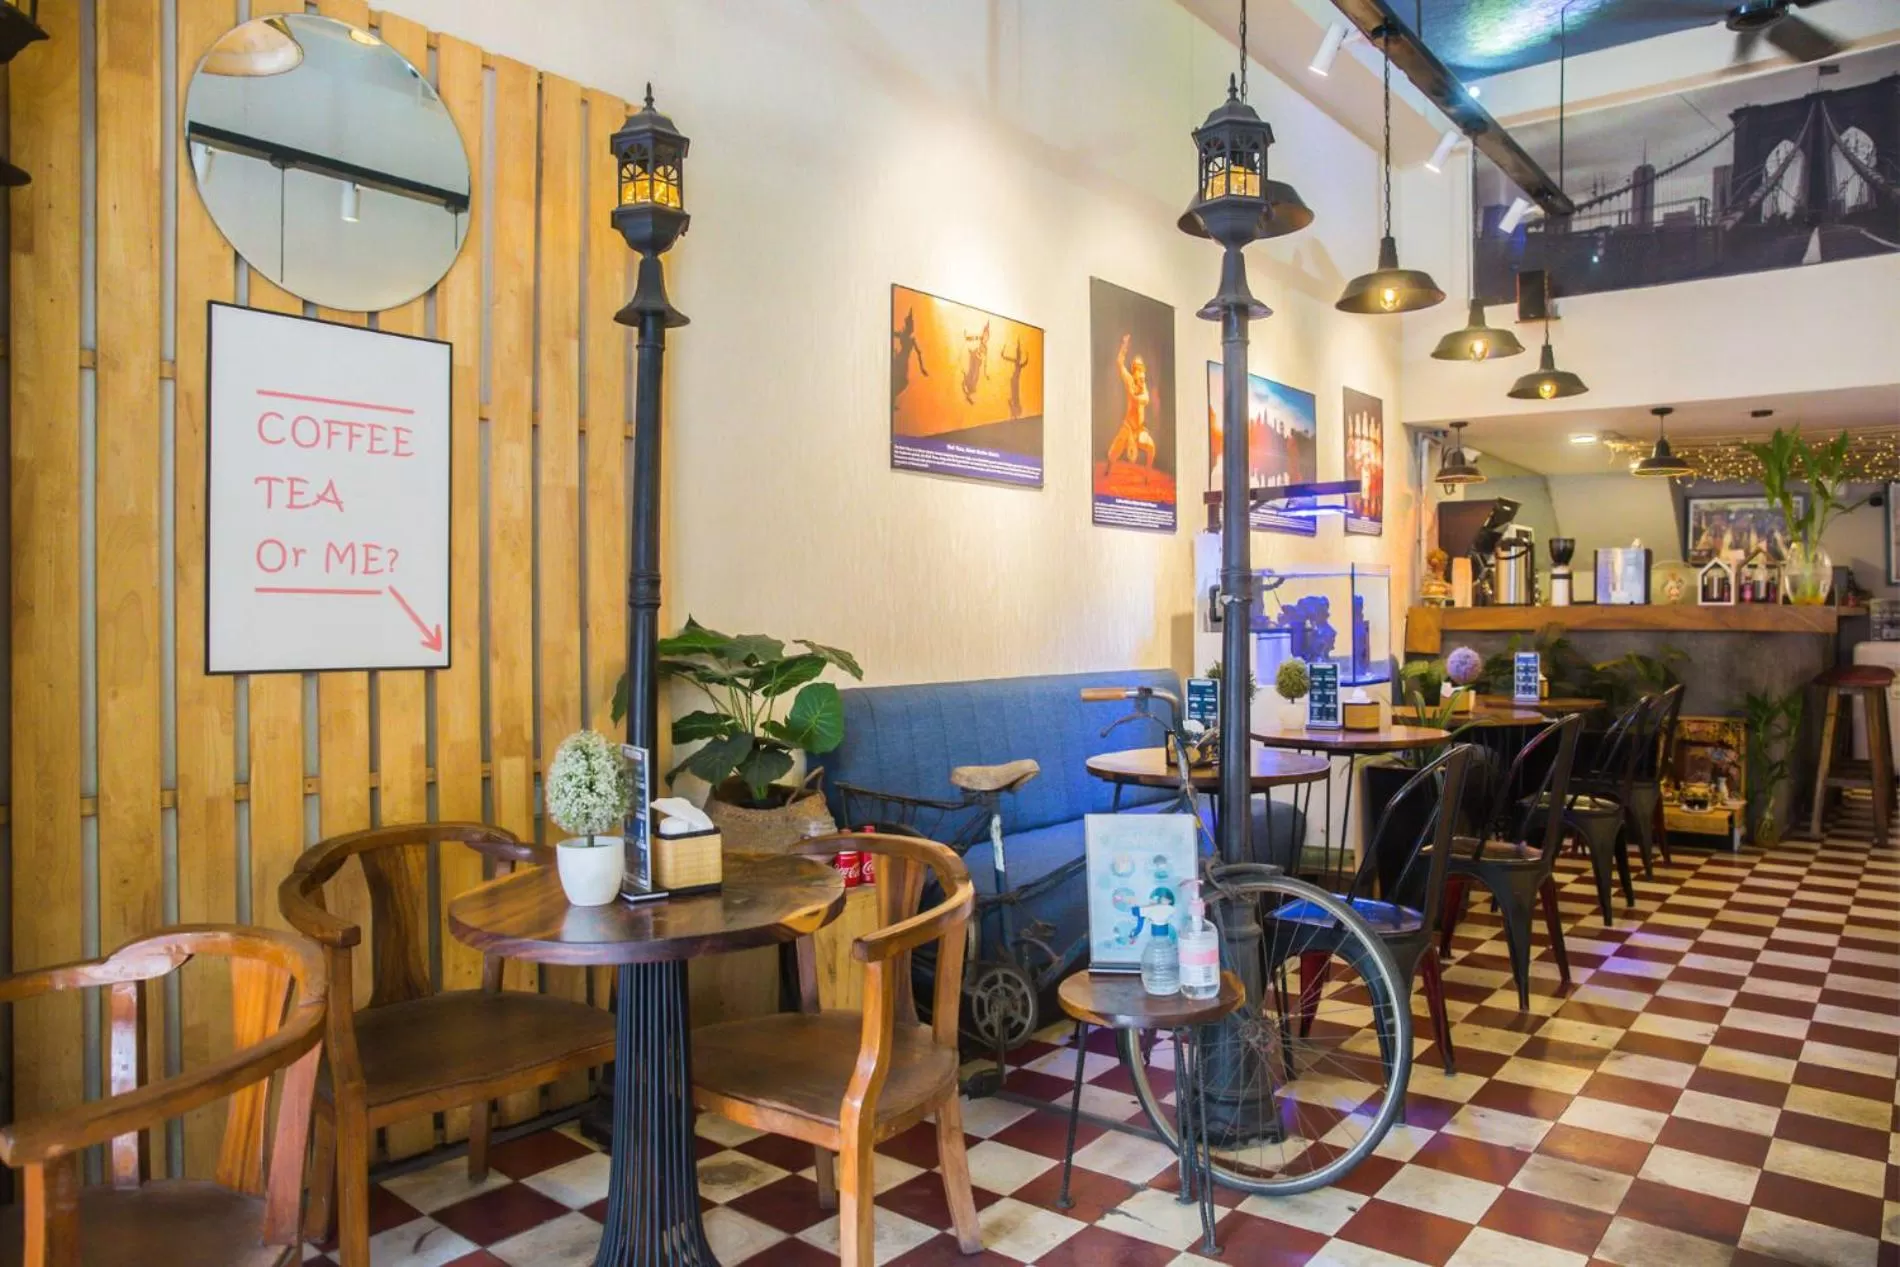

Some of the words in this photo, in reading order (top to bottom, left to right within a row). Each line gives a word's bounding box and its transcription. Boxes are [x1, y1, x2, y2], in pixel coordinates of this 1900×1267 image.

[257, 411, 414, 457] COFFEE
[255, 476, 344, 512] TEA
[256, 538, 306, 574] Or
[325, 542, 399, 575] ME?
